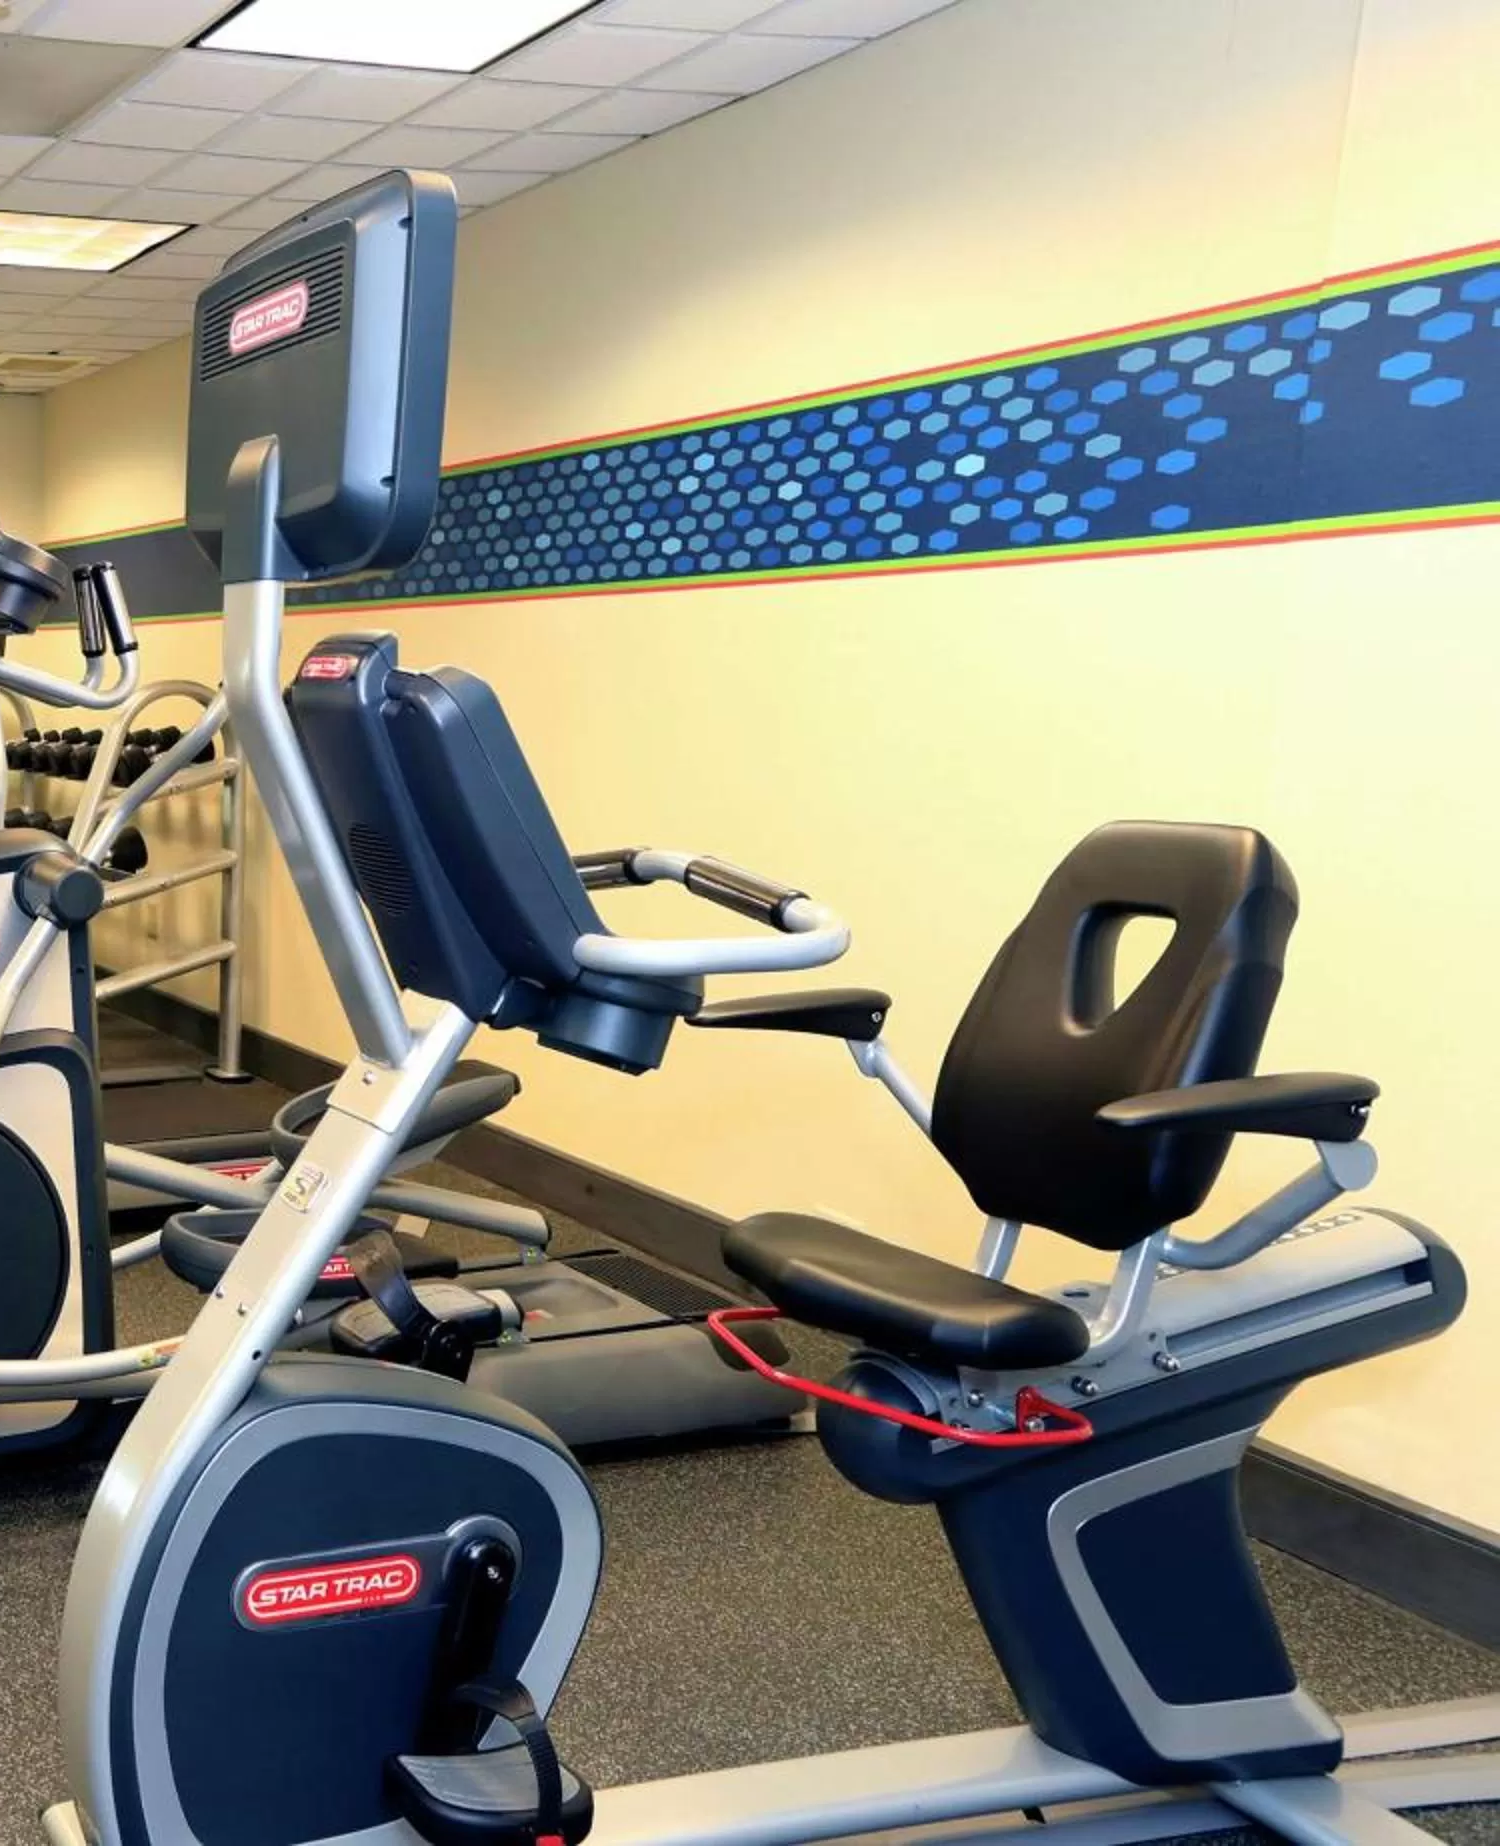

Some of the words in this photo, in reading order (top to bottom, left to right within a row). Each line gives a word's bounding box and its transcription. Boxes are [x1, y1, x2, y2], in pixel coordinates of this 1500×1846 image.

[265, 298, 301, 326] TRAC
[259, 1582, 329, 1605] STAR
[332, 1570, 403, 1594] TRAC
